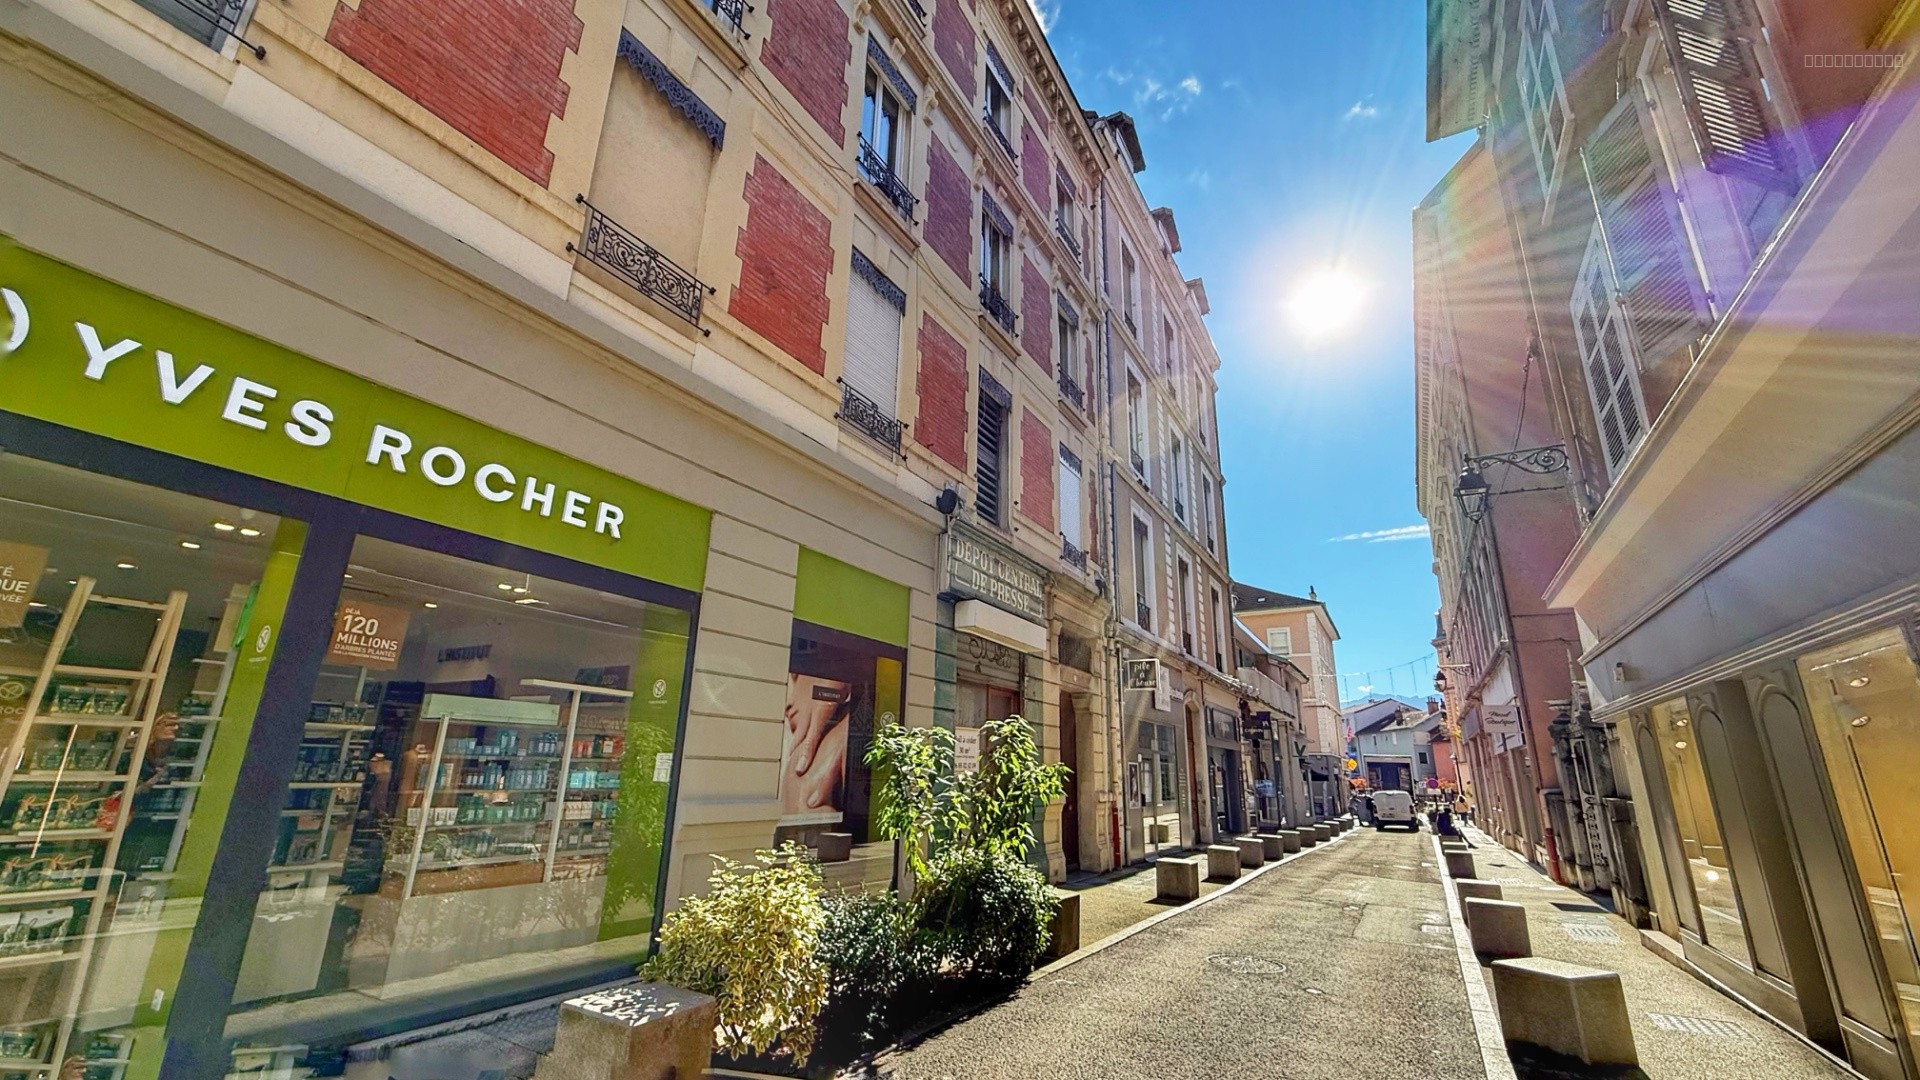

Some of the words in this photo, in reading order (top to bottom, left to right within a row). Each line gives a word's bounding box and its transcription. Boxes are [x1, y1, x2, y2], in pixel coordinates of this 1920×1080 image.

[75, 321, 334, 447] YVES
[365, 424, 624, 538] ROCHER
[972, 569, 987, 594] DE
[989, 579, 1030, 612] PRESSE
[998, 561, 1042, 598] CENTRAL
[343, 614, 379, 636] 120
[336, 632, 398, 651] MILLIONS
[1134, 661, 1150, 673] pile
